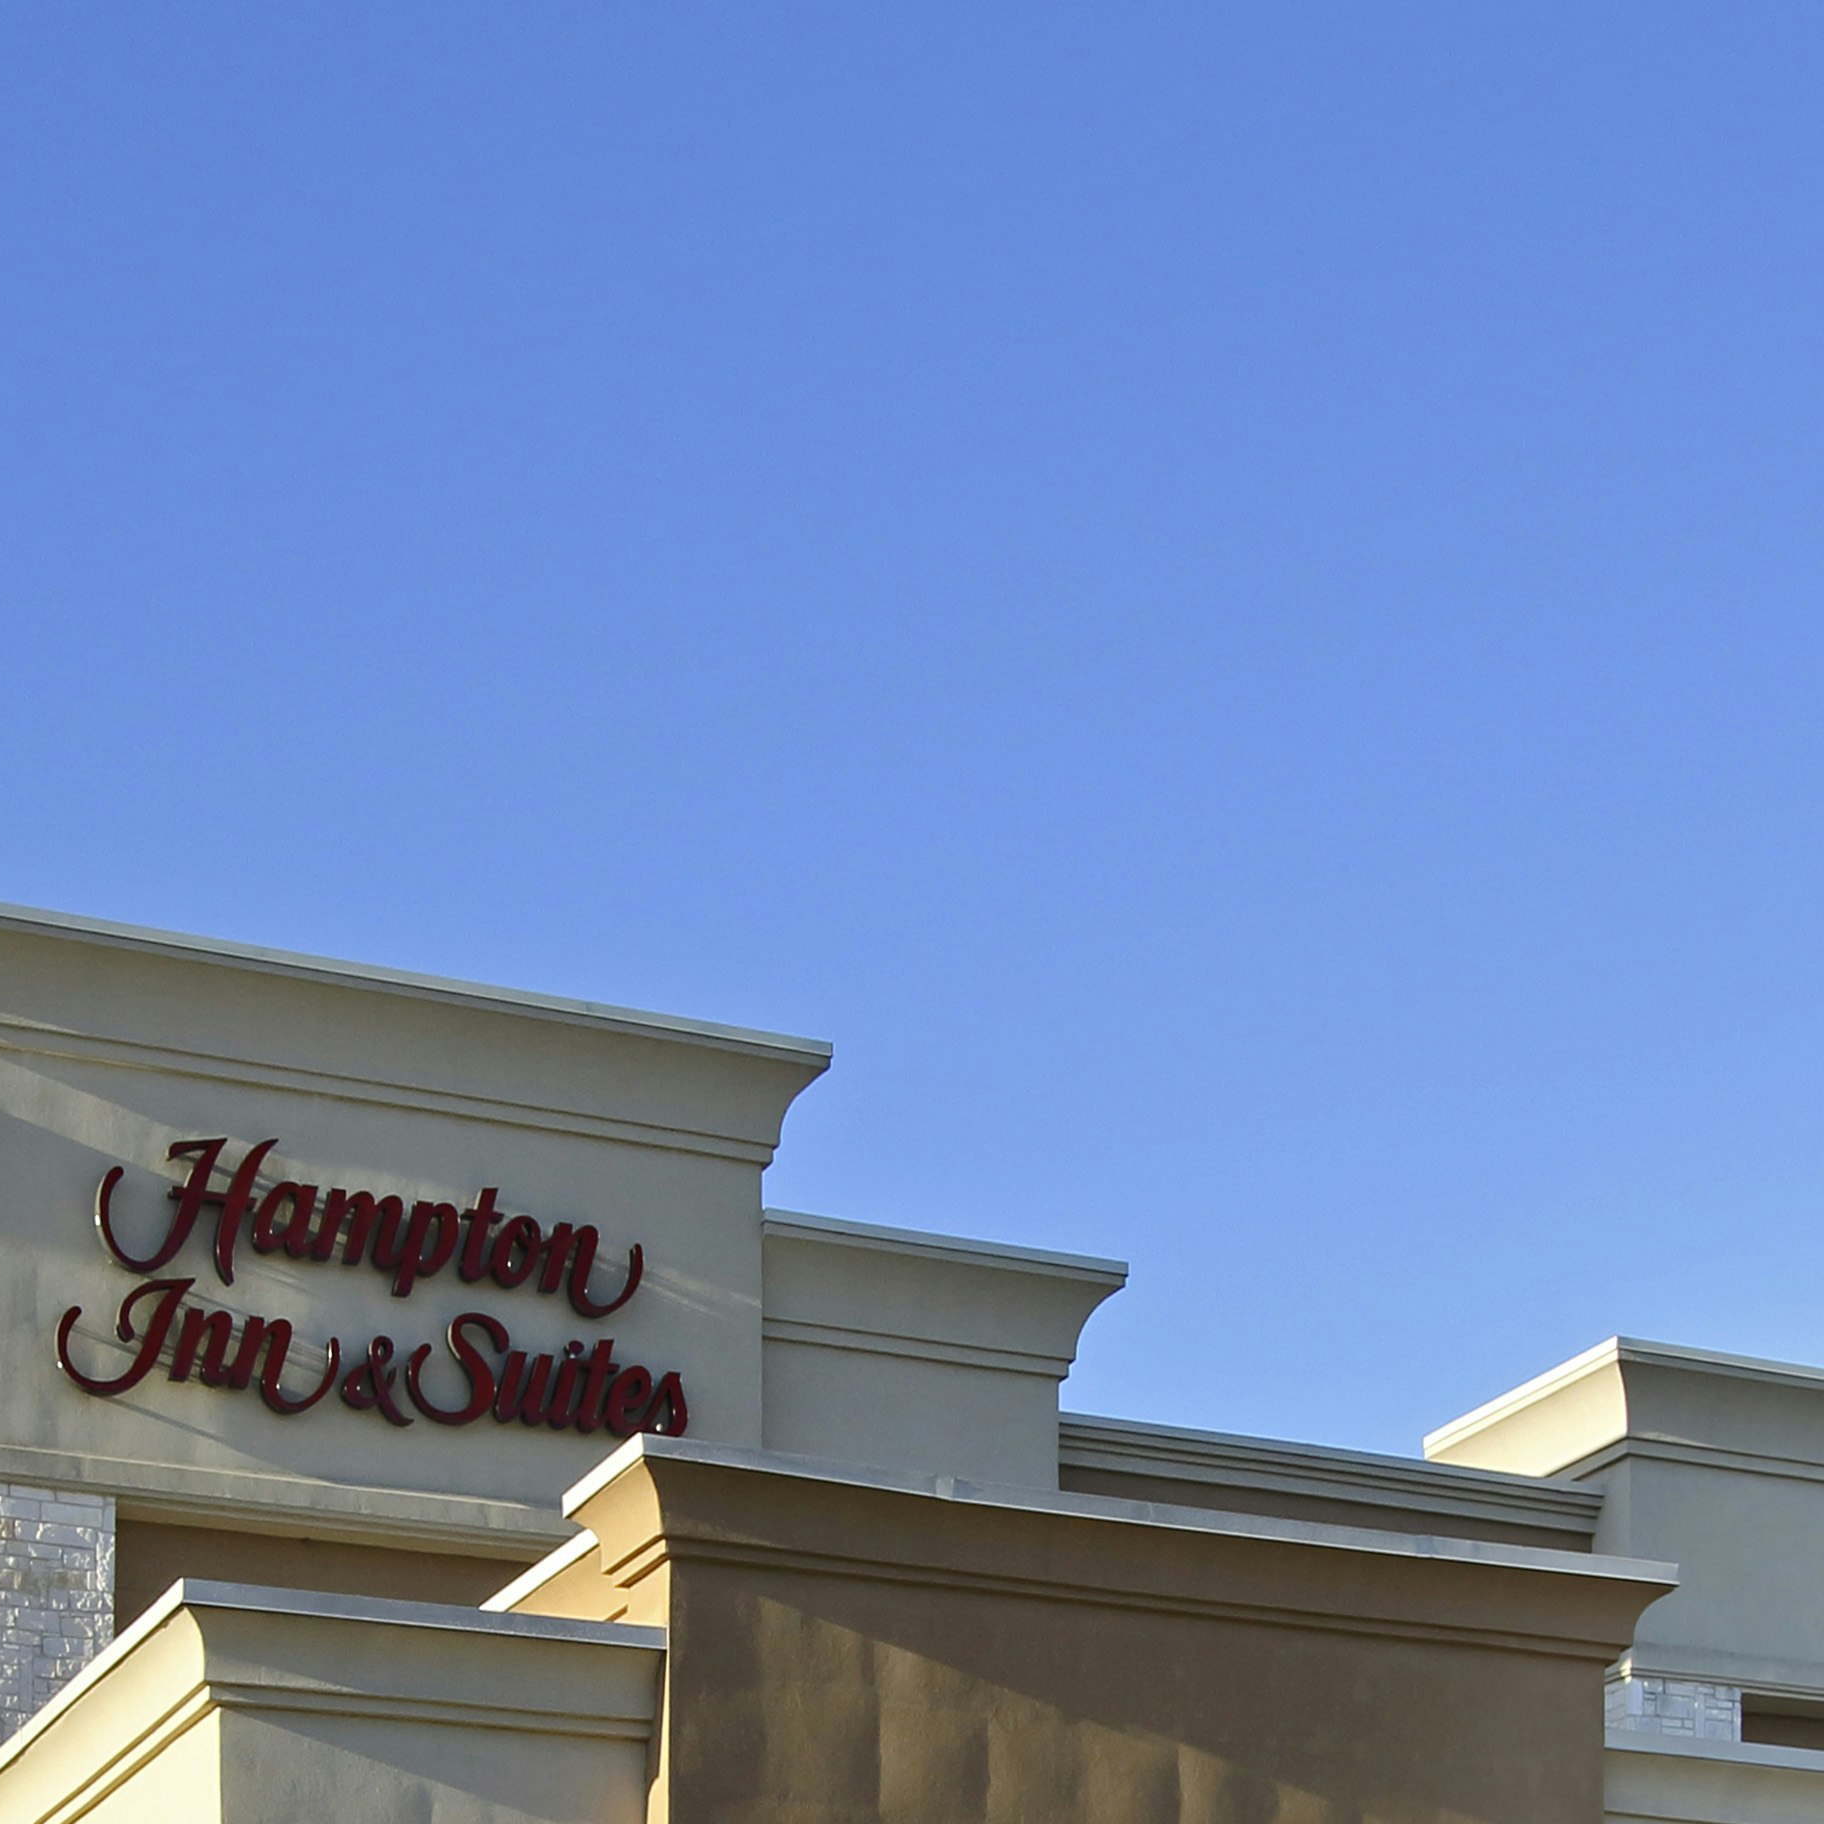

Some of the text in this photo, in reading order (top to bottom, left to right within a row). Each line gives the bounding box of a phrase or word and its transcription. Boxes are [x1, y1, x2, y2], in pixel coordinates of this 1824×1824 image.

[95, 1138, 644, 1319] Hampton
[57, 1277, 689, 1438] Inn & Suites
